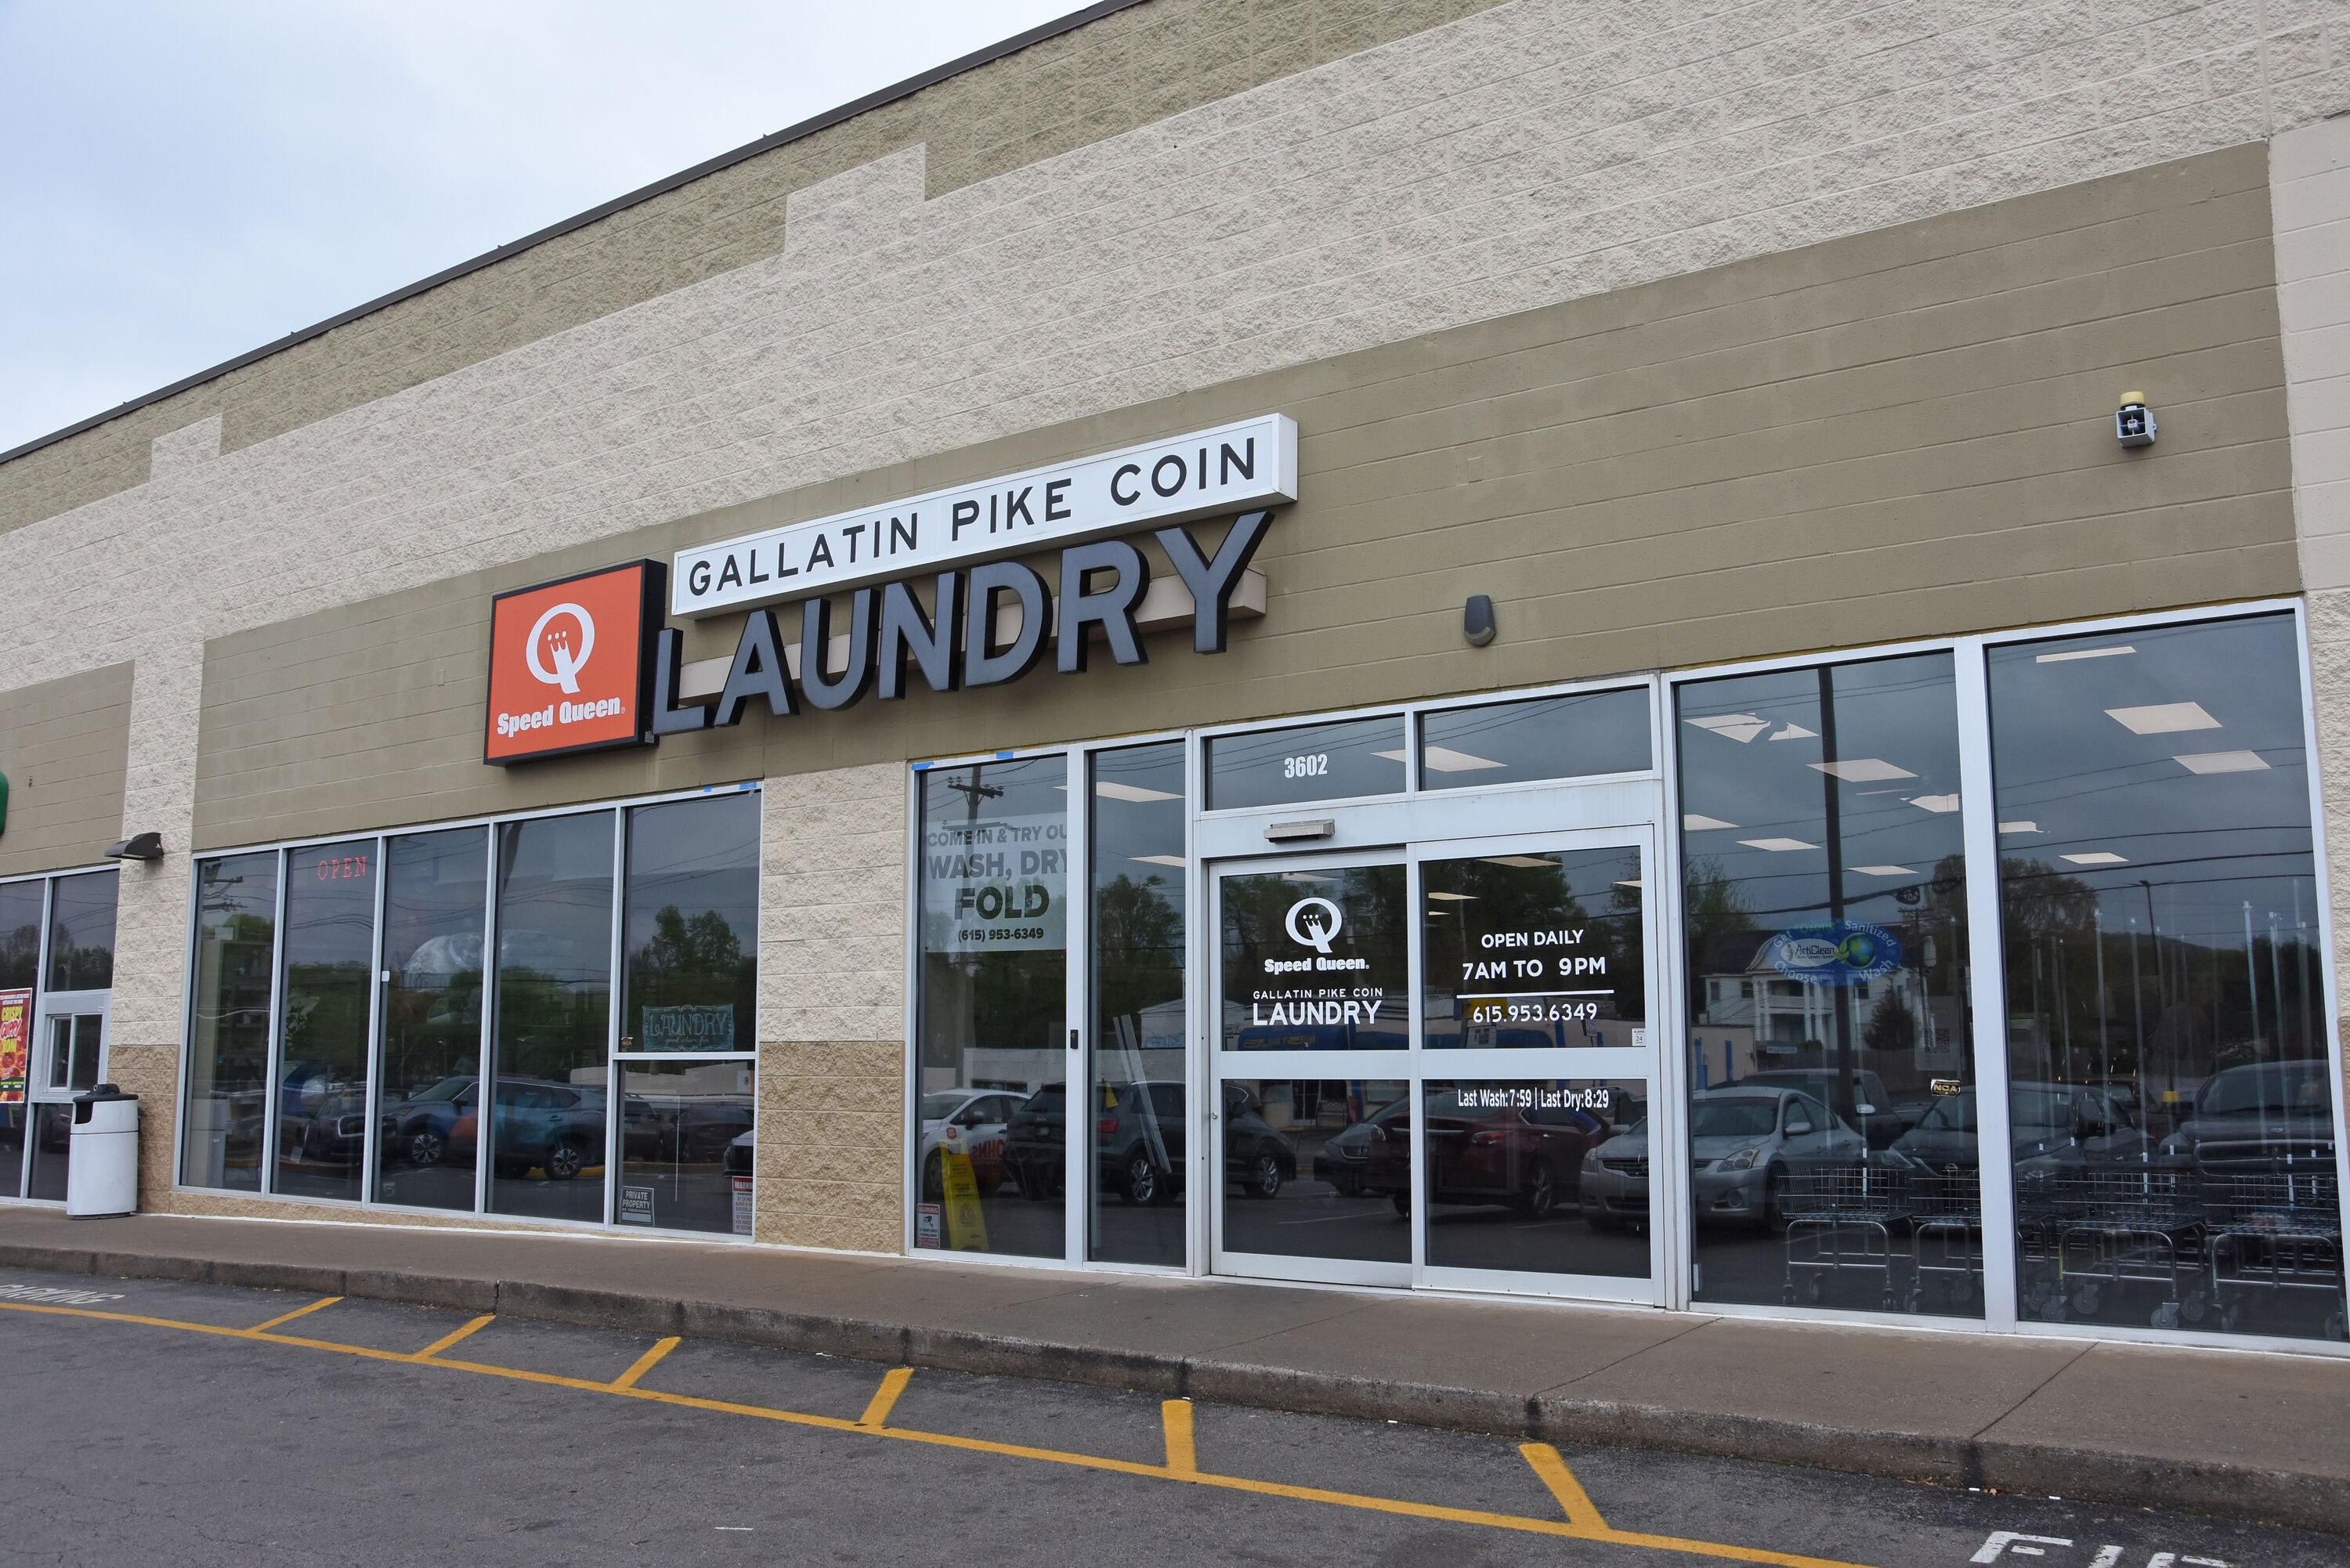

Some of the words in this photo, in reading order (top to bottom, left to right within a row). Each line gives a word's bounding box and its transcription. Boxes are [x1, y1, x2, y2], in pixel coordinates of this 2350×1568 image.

[689, 512, 918, 597] GALLATIN
[951, 477, 1072, 542] PIKE
[1109, 436, 1255, 507] COIN
[652, 509, 1275, 736] LAUNDRY
[497, 705, 554, 738] Speed
[559, 696, 621, 724] Queen
[1285, 753, 1328, 779] 3602
[927, 830, 973, 847] COME
[976, 829, 993, 844] IN
[996, 828, 1007, 843] &
[1011, 826, 1043, 842] TRY
[317, 856, 368, 880] OPEN
[927, 851, 1013, 881] WASH,
[954, 884, 1050, 920] FOLD
[958, 929, 986, 943] (615)
[989, 927, 1044, 941] 953-6349
[1481, 932, 1528, 948] OPEN
[1534, 929, 1584, 946] DAILY
[1773, 930, 1793, 948] Get
[1844, 920, 1897, 948] Sanitized
[1795, 945, 1835, 955] ArtiClean
[1264, 958, 1312, 975] Speed
[1316, 956, 1366, 971] Queen
[1462, 961, 1506, 981] 7AM
[1513, 959, 1543, 977] TO
[1559, 956, 1606, 976] 9PM
[1774, 960, 1817, 985] Choose
[1858, 959, 1894, 981] Wash
[1253, 989, 1312, 999] GALLATIN
[1318, 988, 1347, 998] PIKE
[1353, 988, 1383, 997] COIN
[2, 1006, 24, 1021] CRISPY
[1253, 999, 1383, 1026] LAUNDRY
[1473, 1003, 1598, 1023] 615.953.6349
[649, 1012, 728, 1036] LAUNDRY
[1458, 1089, 1478, 1107] Last
[1541, 1089, 1561, 1107] Last
[1933, 1084, 1958, 1093] NCA
[622, 1199, 651, 1209] PROPERTY
[626, 1190, 648, 1200] PRIVATE
